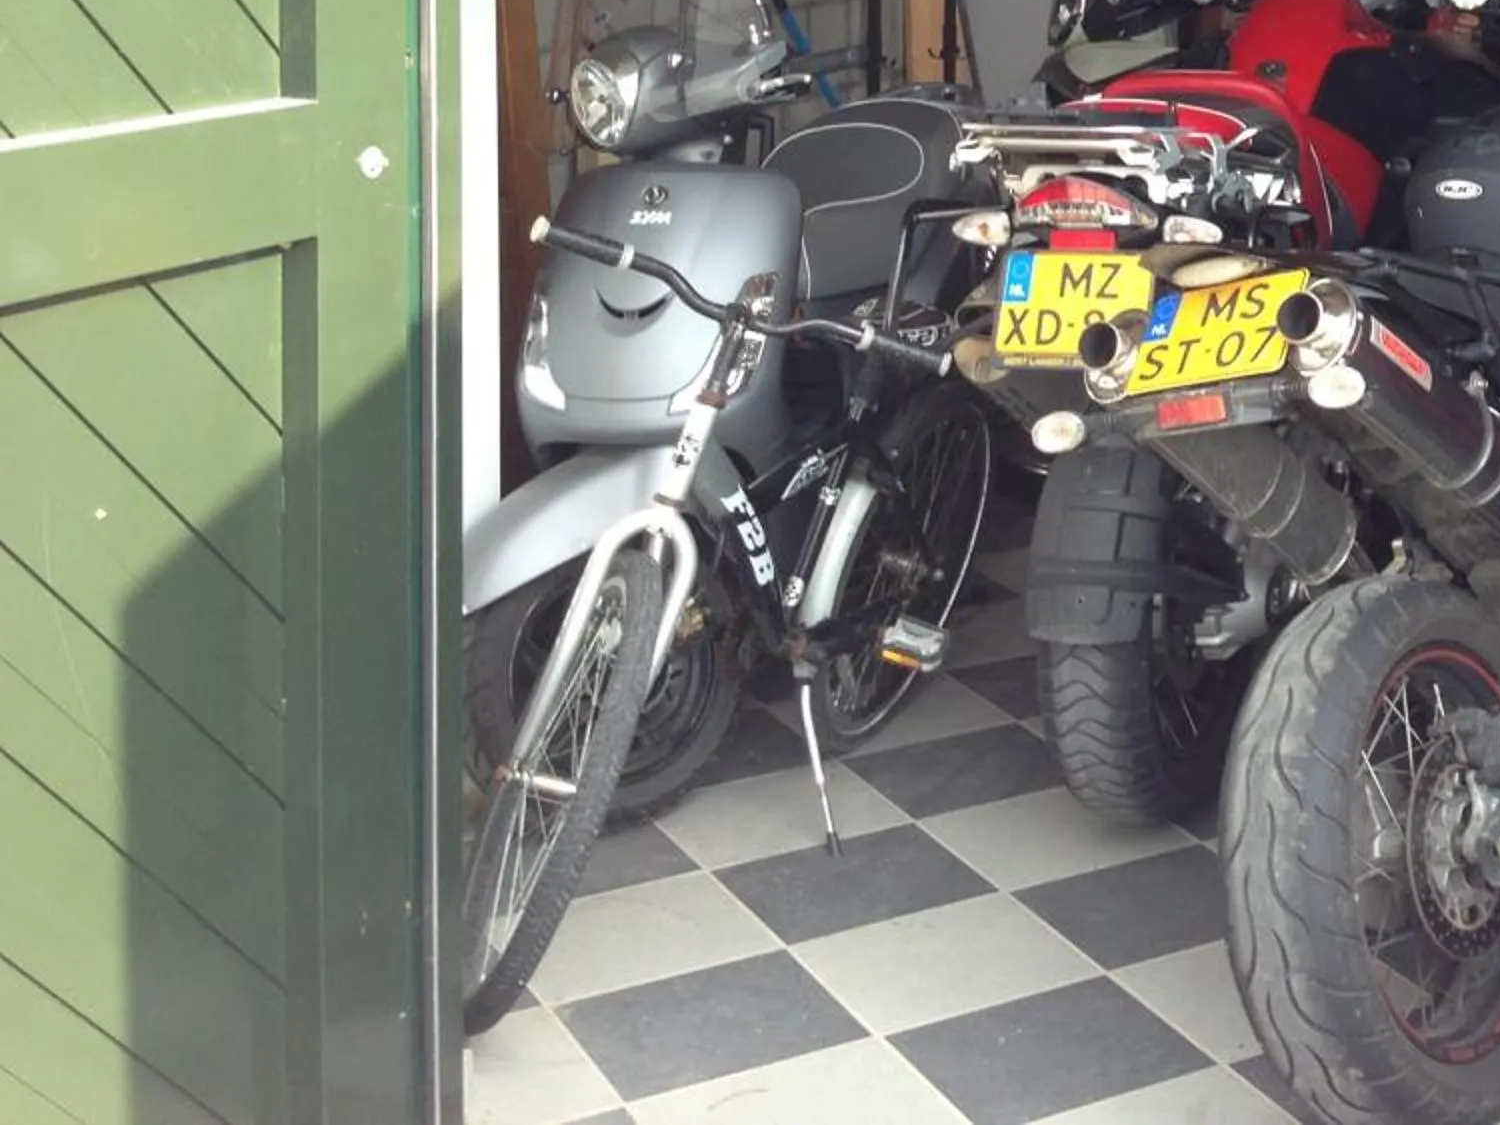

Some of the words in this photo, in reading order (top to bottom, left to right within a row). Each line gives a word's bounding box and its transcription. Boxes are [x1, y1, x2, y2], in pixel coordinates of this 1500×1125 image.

[1059, 262, 1122, 298] MZ
[1200, 282, 1270, 327] MS
[1003, 308, 1106, 346] XD-
[1151, 324, 1168, 336] NL
[1138, 325, 1278, 380] ST-07
[720, 484, 775, 586] F2B
